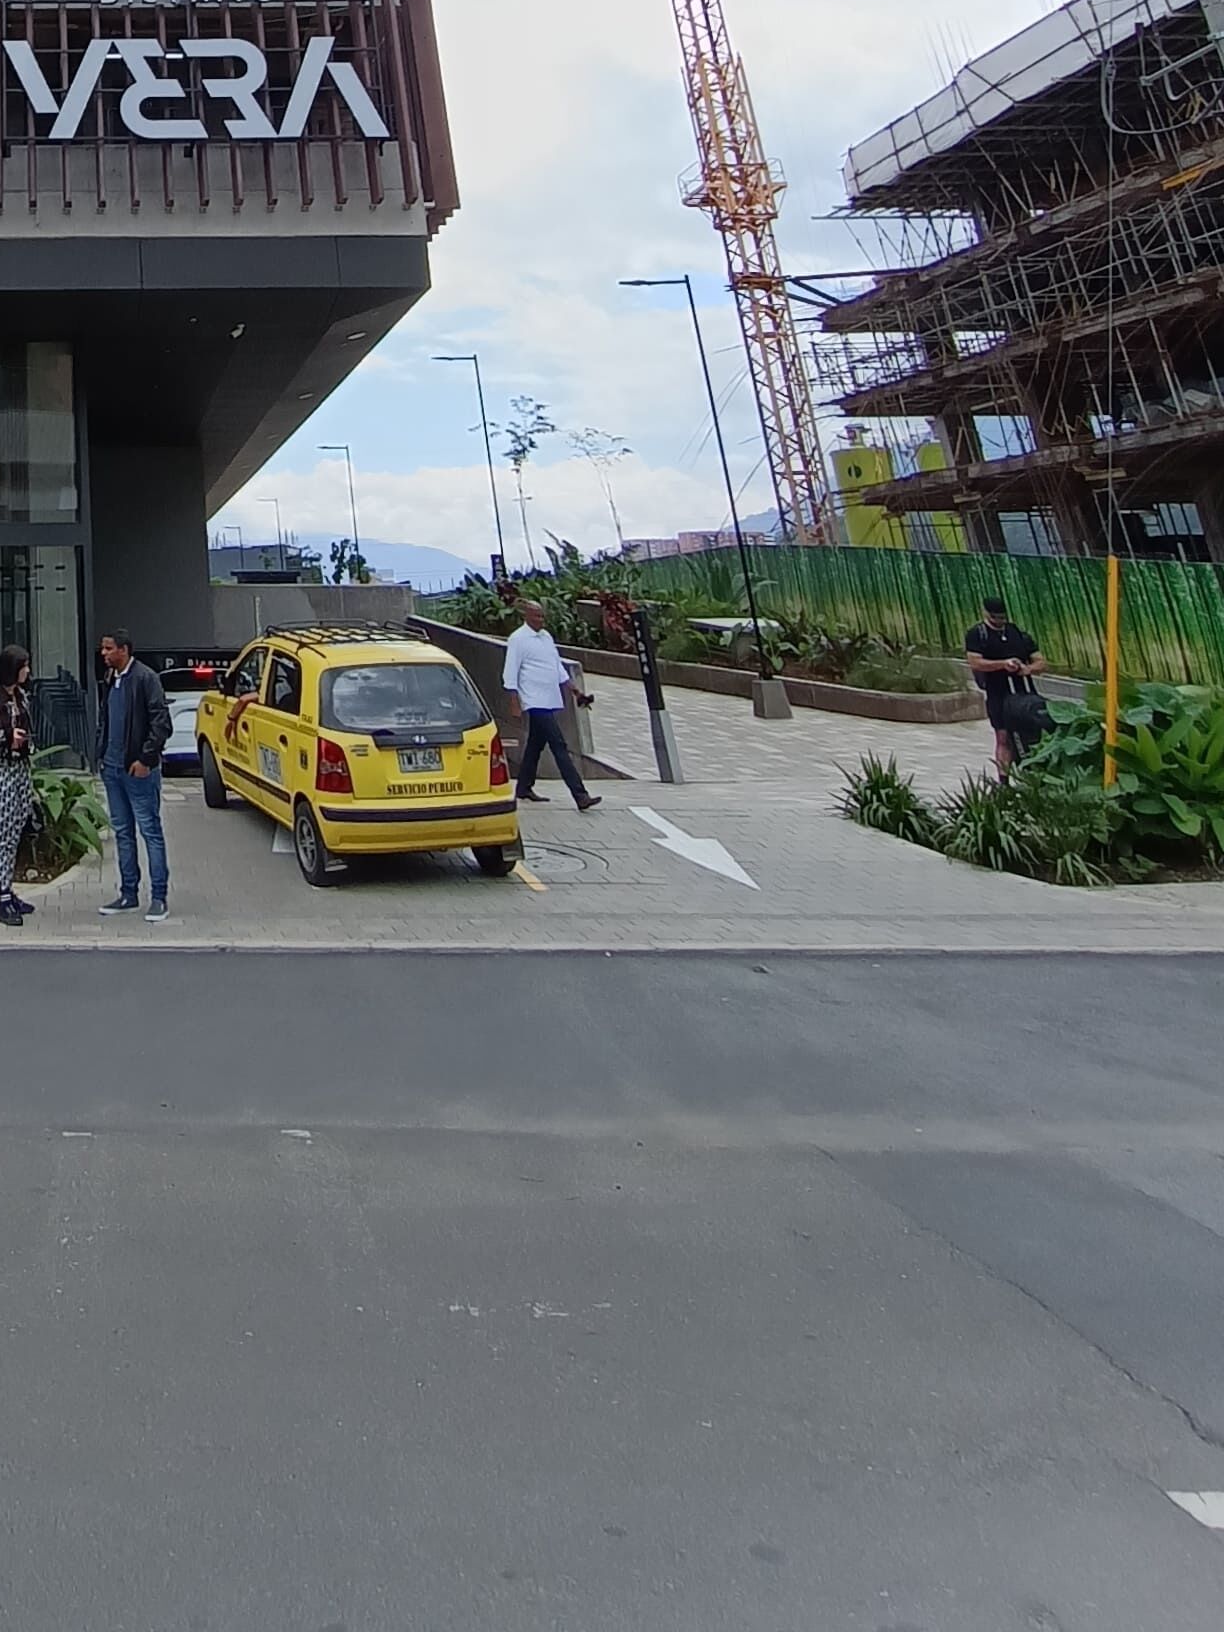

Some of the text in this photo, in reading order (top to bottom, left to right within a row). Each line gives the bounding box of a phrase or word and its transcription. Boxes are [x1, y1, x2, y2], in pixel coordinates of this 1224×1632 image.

[2, 36, 391, 139] VERA
[387, 781, 463, 795] SERVICIO PUBLICO
